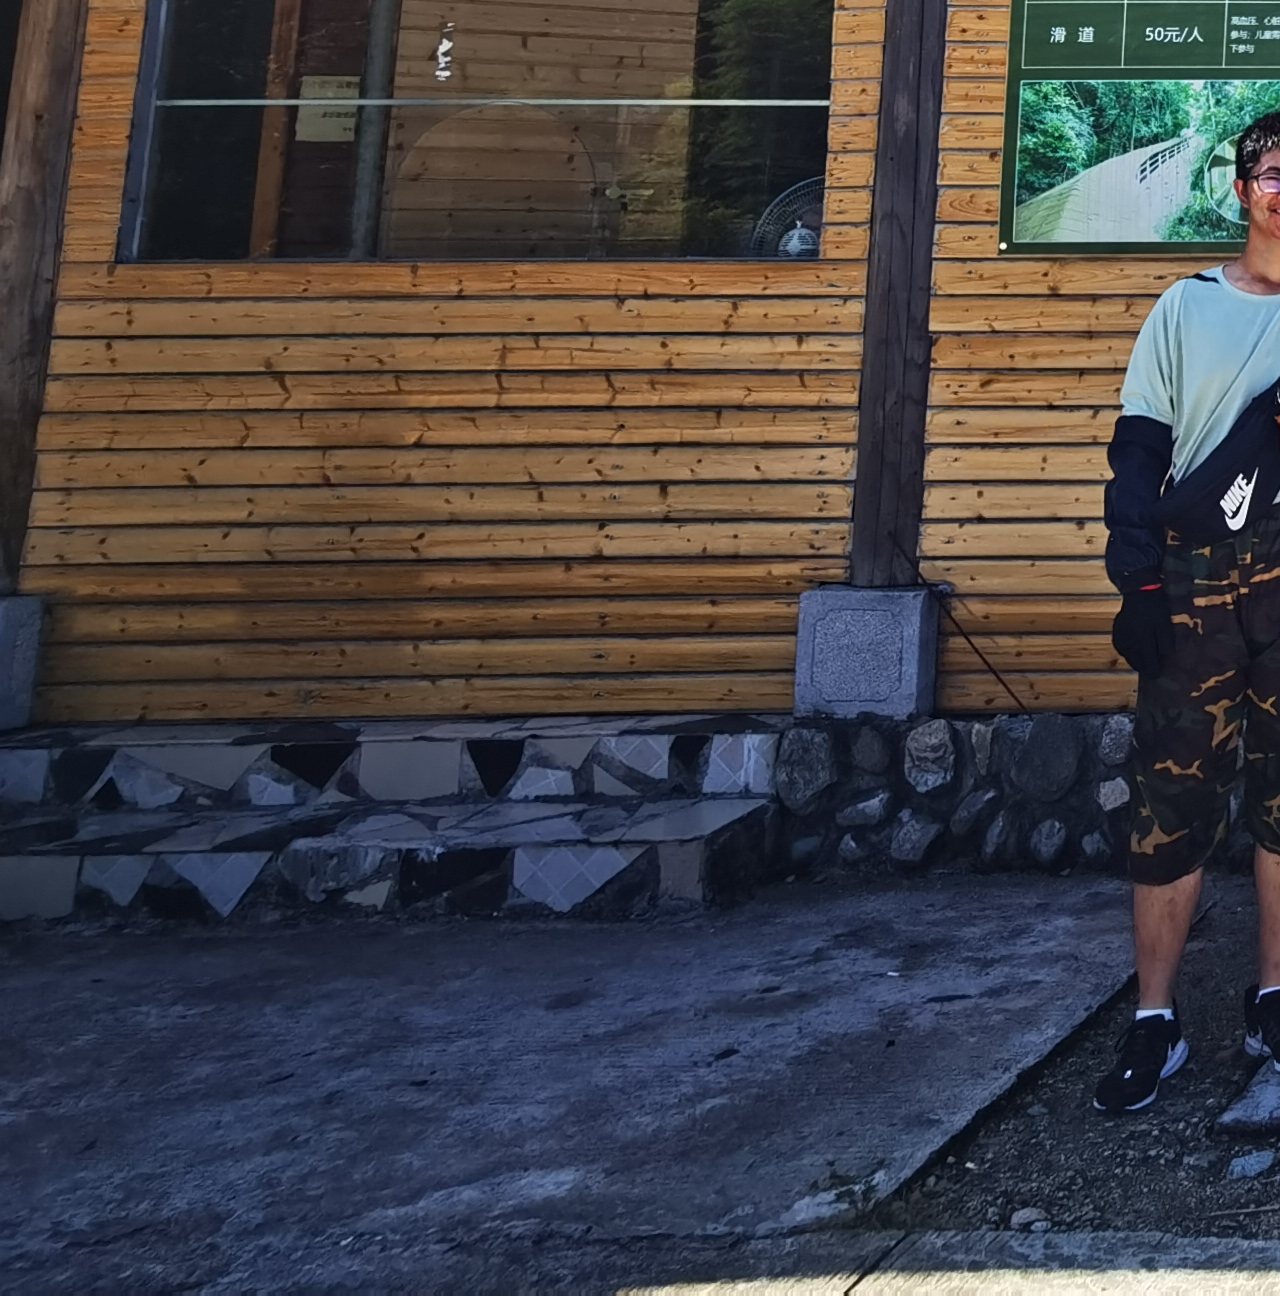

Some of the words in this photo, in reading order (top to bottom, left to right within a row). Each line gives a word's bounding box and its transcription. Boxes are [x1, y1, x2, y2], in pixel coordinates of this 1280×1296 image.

[1049, 26, 1095, 44] 滑道
[1144, 26, 1204, 44] 50元/人
[1219, 472, 1253, 518] NIKE
